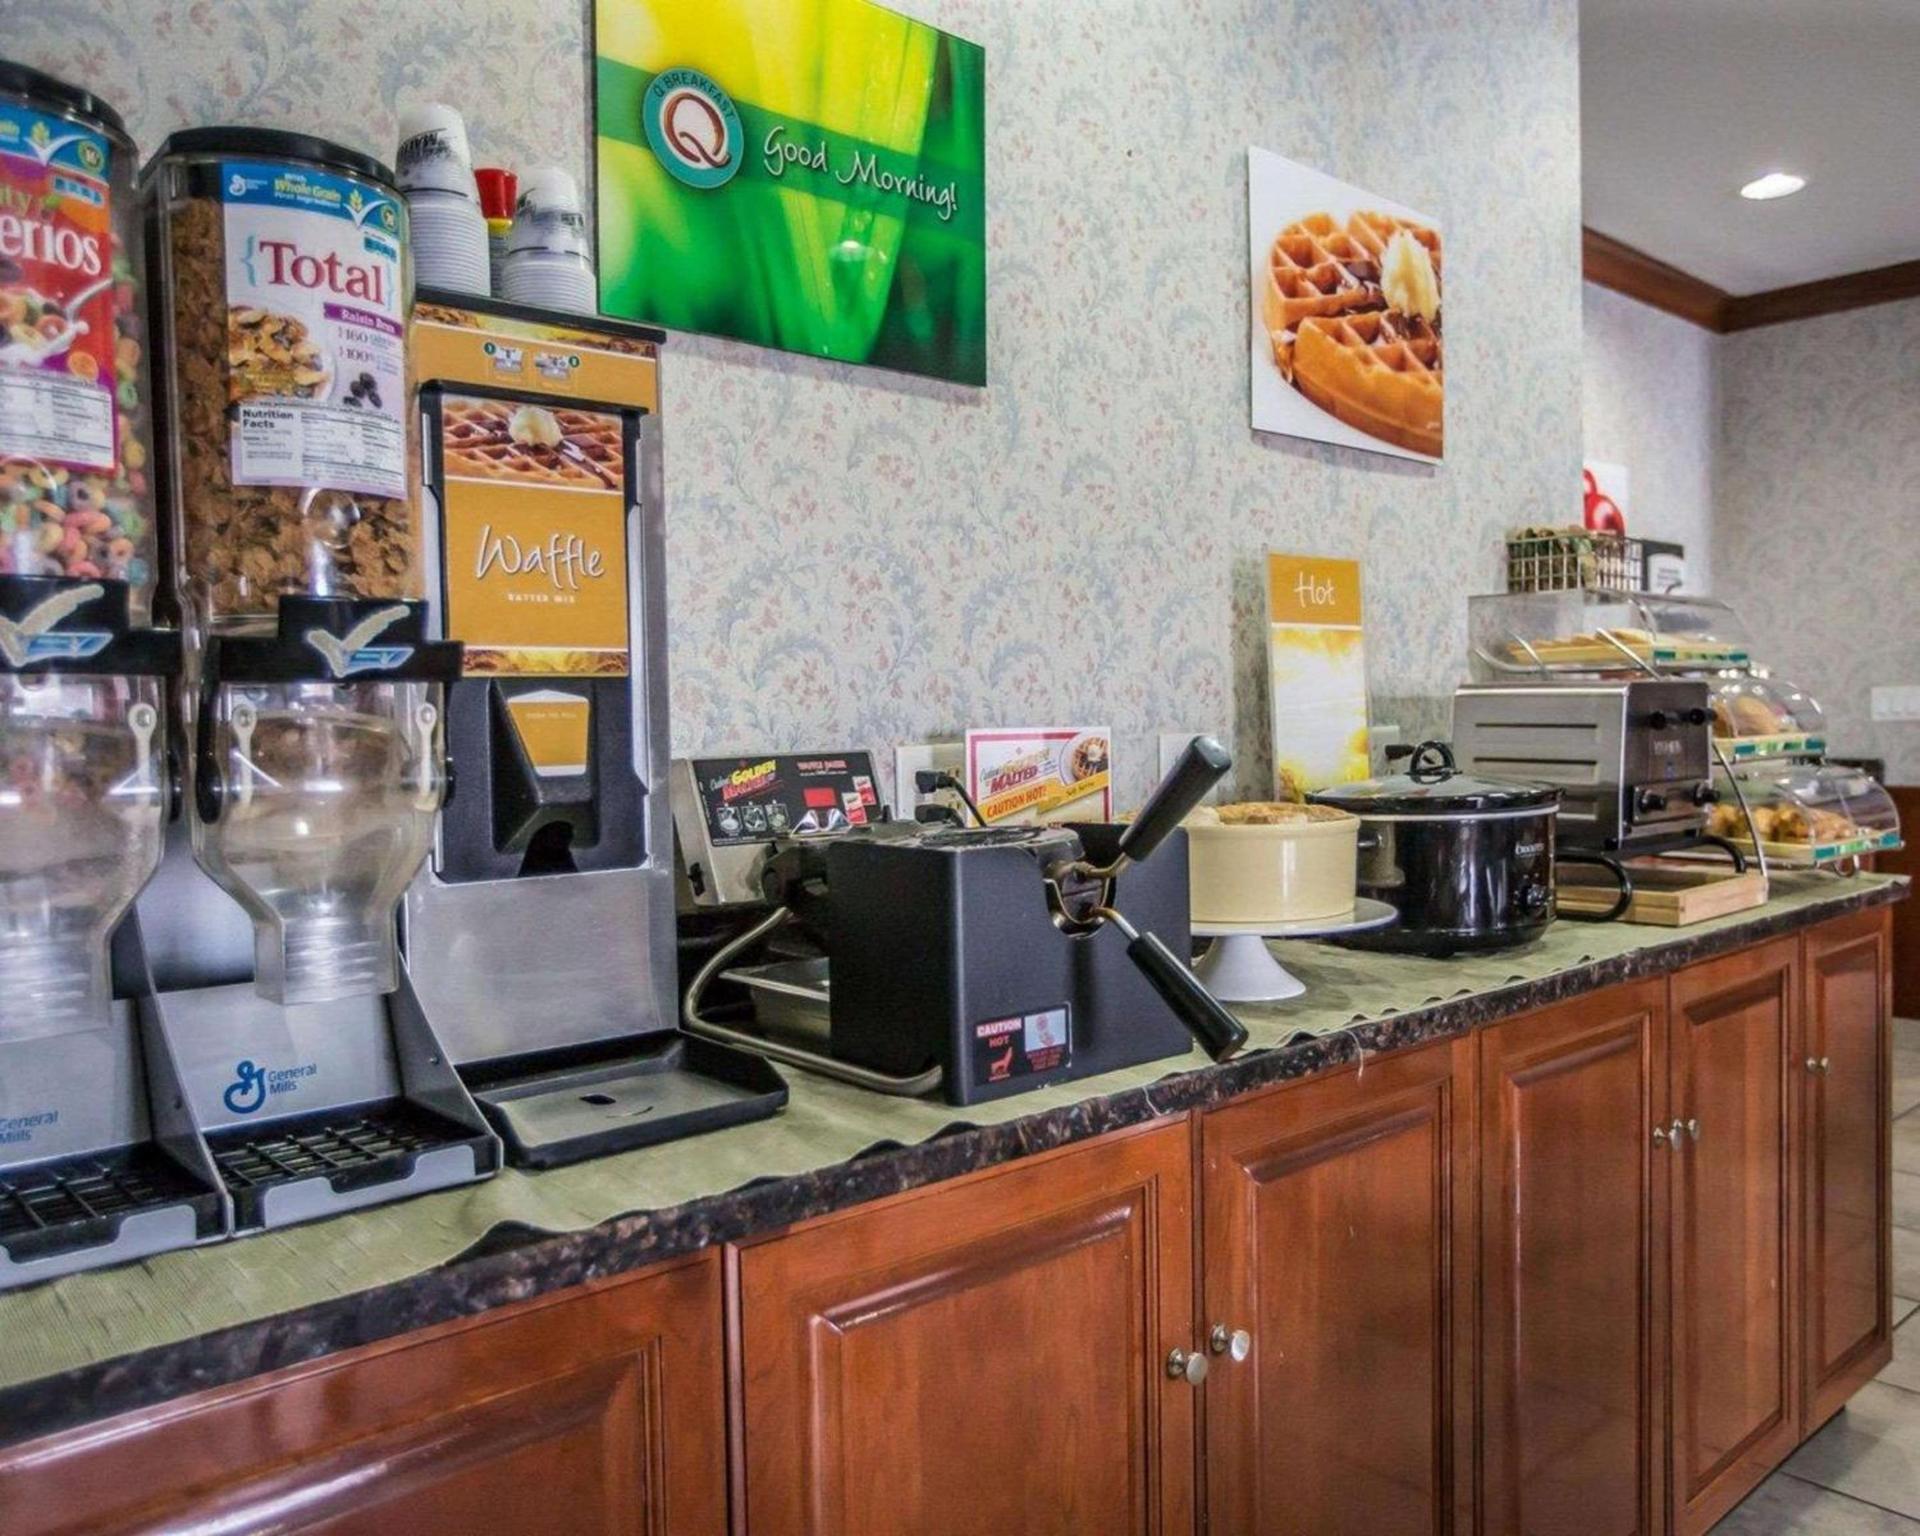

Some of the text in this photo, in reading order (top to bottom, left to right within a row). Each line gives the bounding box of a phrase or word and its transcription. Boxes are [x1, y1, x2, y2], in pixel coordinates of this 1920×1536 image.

[663, 72, 735, 119] BREAKFAST
[763, 125, 958, 221] Good Morning!
[275, 179, 312, 194] Whole
[313, 186, 342, 202] Grain
[259, 240, 384, 306] Total
[341, 310, 374, 327] Raisin
[242, 409, 294, 420] Nutrition
[242, 419, 275, 429] Facts
[476, 524, 605, 591] Waffle
[1294, 571, 1336, 608] Hot
[732, 760, 776, 786] GOLDEN
[991, 765, 1038, 793] MALTED
[987, 794, 1024, 818] CAUTION
[977, 1018, 1022, 1038] CAUTION
[988, 1035, 1009, 1049] HOT
[268, 1063, 318, 1082] General
[269, 1080, 297, 1095] Mills
